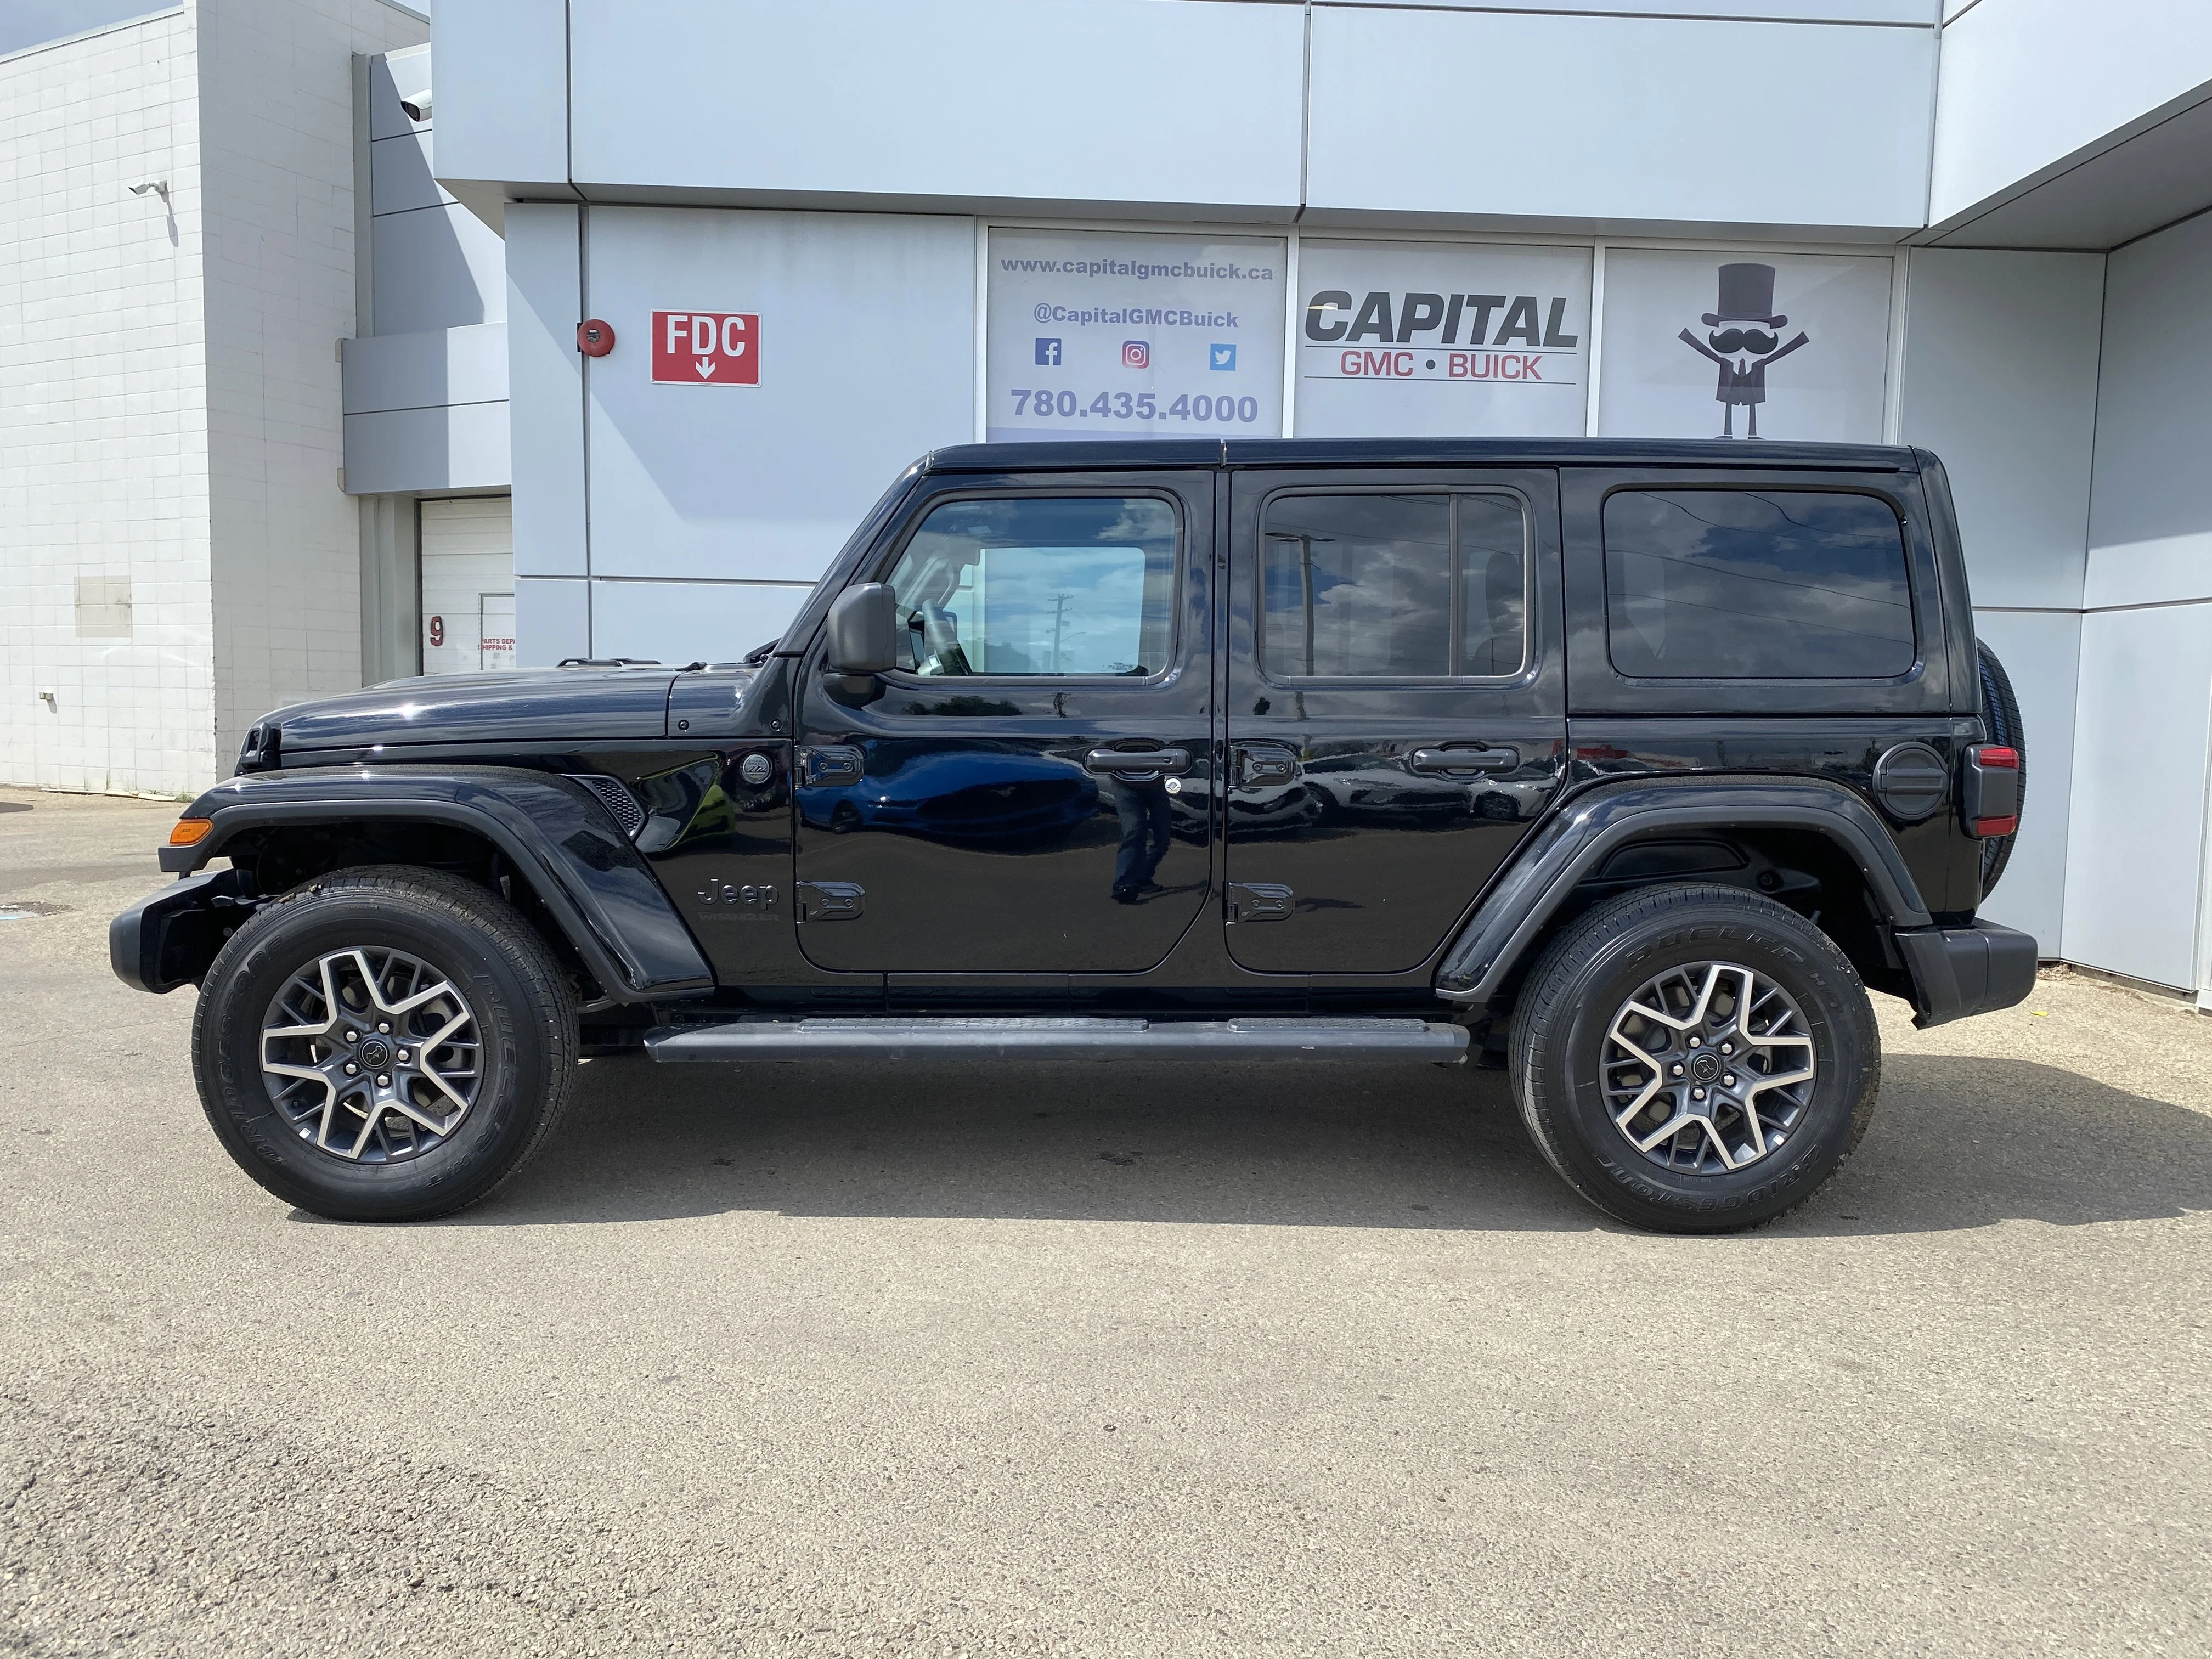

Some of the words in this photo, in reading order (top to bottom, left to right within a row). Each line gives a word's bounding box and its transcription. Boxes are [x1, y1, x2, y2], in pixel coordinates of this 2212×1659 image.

[1001, 258, 1273, 280] www.capitalgmcbuick.ca
[1034, 302, 1239, 328] @CapitalGMCBuick
[1305, 290, 1577, 348] CAPITAL
[667, 314, 746, 357] FDC
[1340, 350, 1414, 377] GMC
[1448, 352, 1543, 380] BUICK
[1011, 388, 1258, 423] 780.435.4000
[430, 616, 445, 647] 9
[697, 878, 780, 911] Jeep
